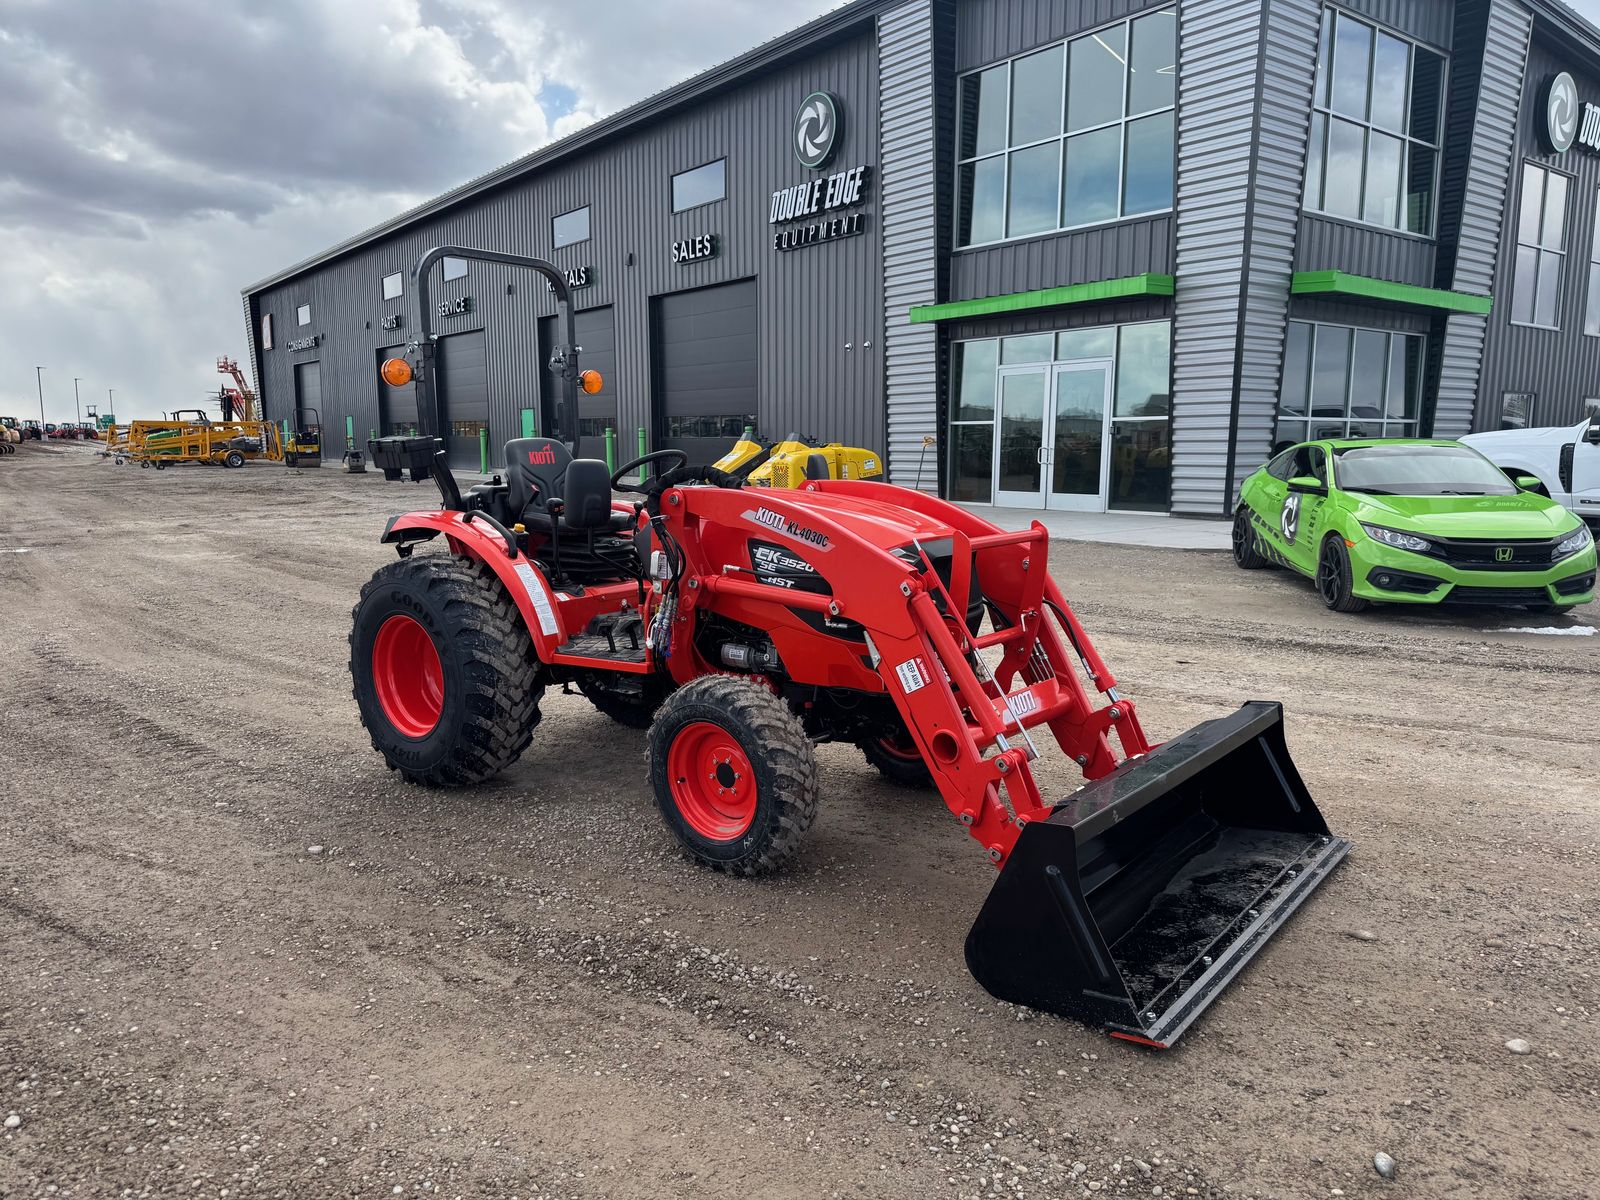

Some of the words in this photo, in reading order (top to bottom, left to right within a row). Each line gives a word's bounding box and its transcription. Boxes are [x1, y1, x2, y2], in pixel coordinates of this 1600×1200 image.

[769, 179, 822, 223] DOUBLE
[825, 166, 865, 209] EDGE
[774, 214, 859, 249] EQUIPMENT
[672, 234, 711, 263] SALES
[438, 298, 465, 317] SERVICE
[381, 315, 397, 331] PARTS
[528, 451, 556, 465] KIOTI
[755, 507, 785, 530] KIOTI
[786, 521, 828, 547] KL4030C
[906, 661, 916, 674] KEEP
[911, 674, 922, 688] AWAY
[1008, 690, 1036, 716] KIOTI
